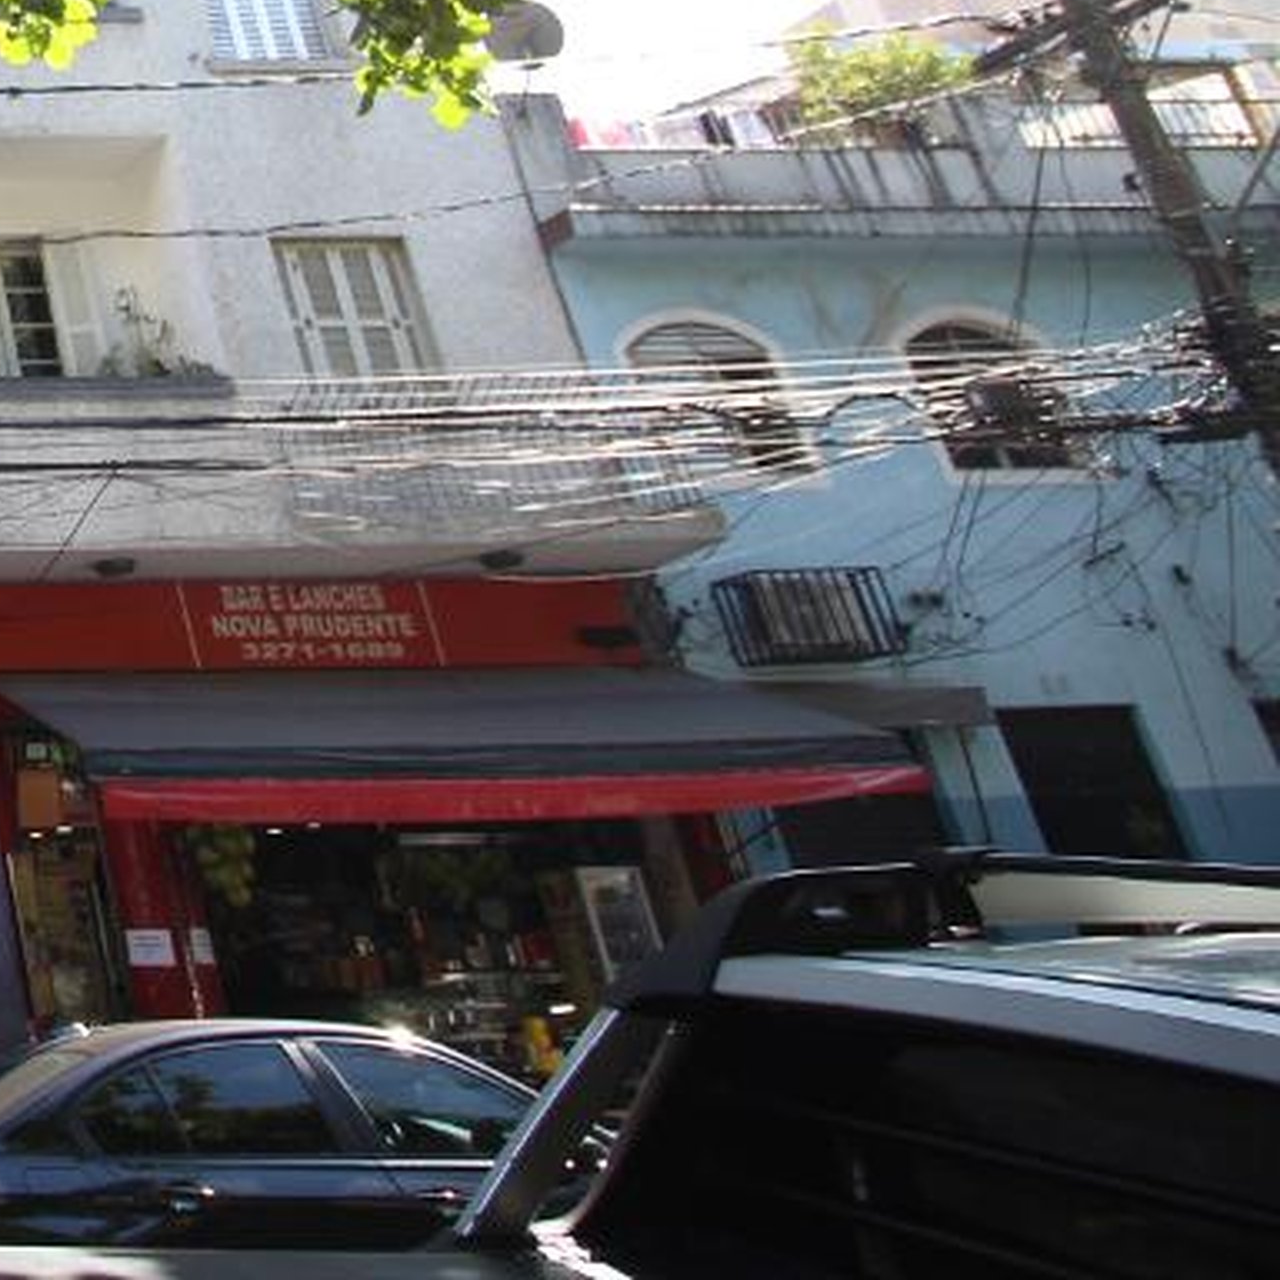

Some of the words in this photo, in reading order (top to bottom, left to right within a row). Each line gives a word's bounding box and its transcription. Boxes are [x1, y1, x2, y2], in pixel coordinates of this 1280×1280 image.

[220, 585, 266, 611] BAR
[268, 585, 285, 611] E
[287, 584, 386, 611] LANCHES
[212, 614, 279, 638] NOVA
[283, 613, 418, 637] PRUDENTE
